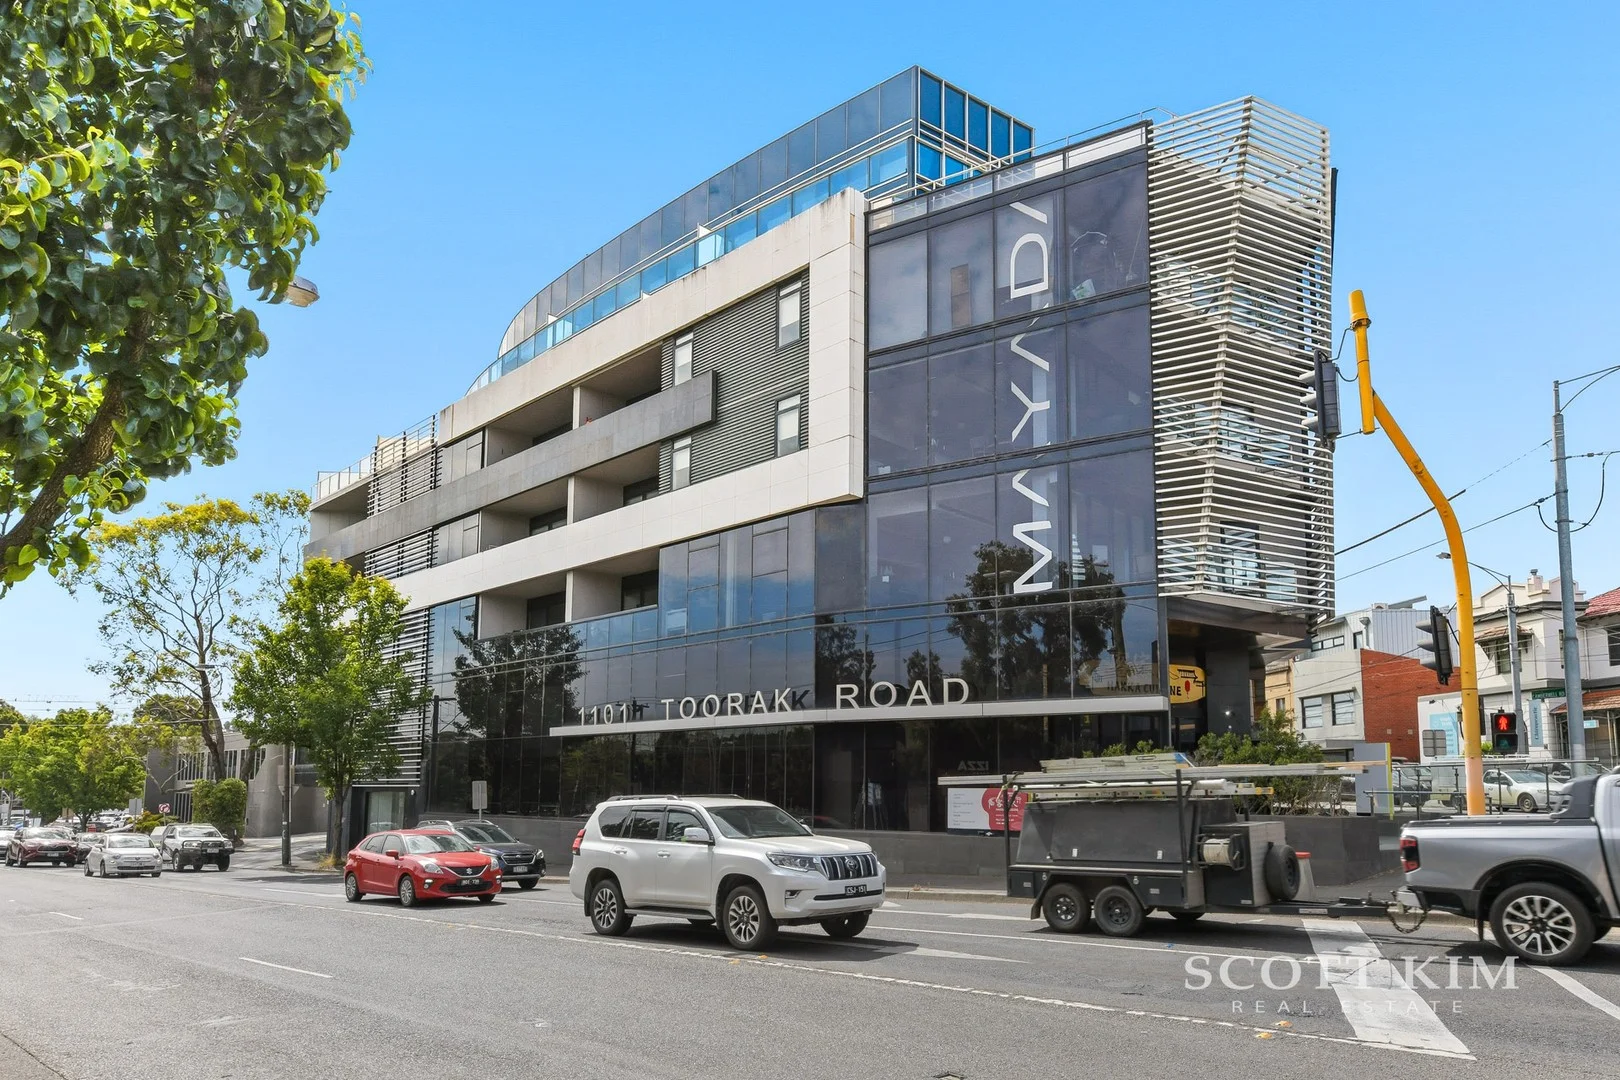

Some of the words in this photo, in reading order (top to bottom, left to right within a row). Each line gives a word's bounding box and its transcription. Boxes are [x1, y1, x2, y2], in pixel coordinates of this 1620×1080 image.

[578, 703, 627, 726] 1101
[660, 686, 793, 721] TOORAK
[835, 677, 970, 710] ROAD
